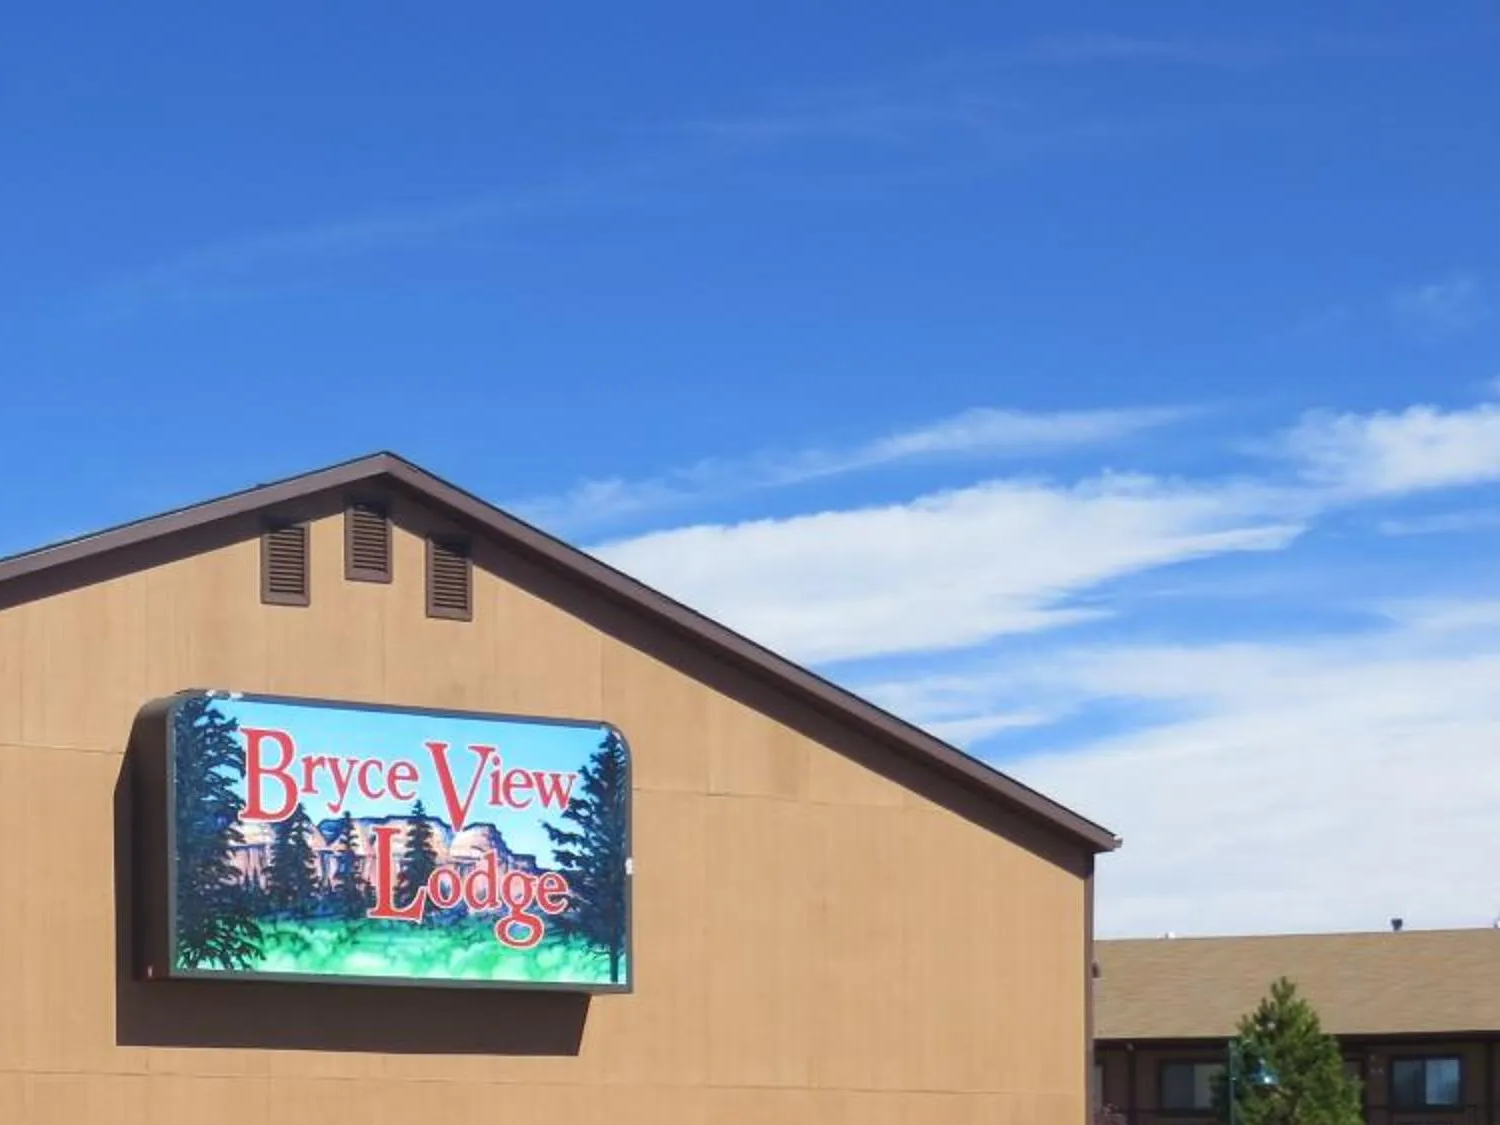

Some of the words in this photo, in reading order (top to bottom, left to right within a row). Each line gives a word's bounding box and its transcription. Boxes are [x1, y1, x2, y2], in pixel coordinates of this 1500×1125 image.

[238, 727, 420, 822] Bryce
[426, 741, 578, 833] View
[368, 826, 569, 948] Lodge
